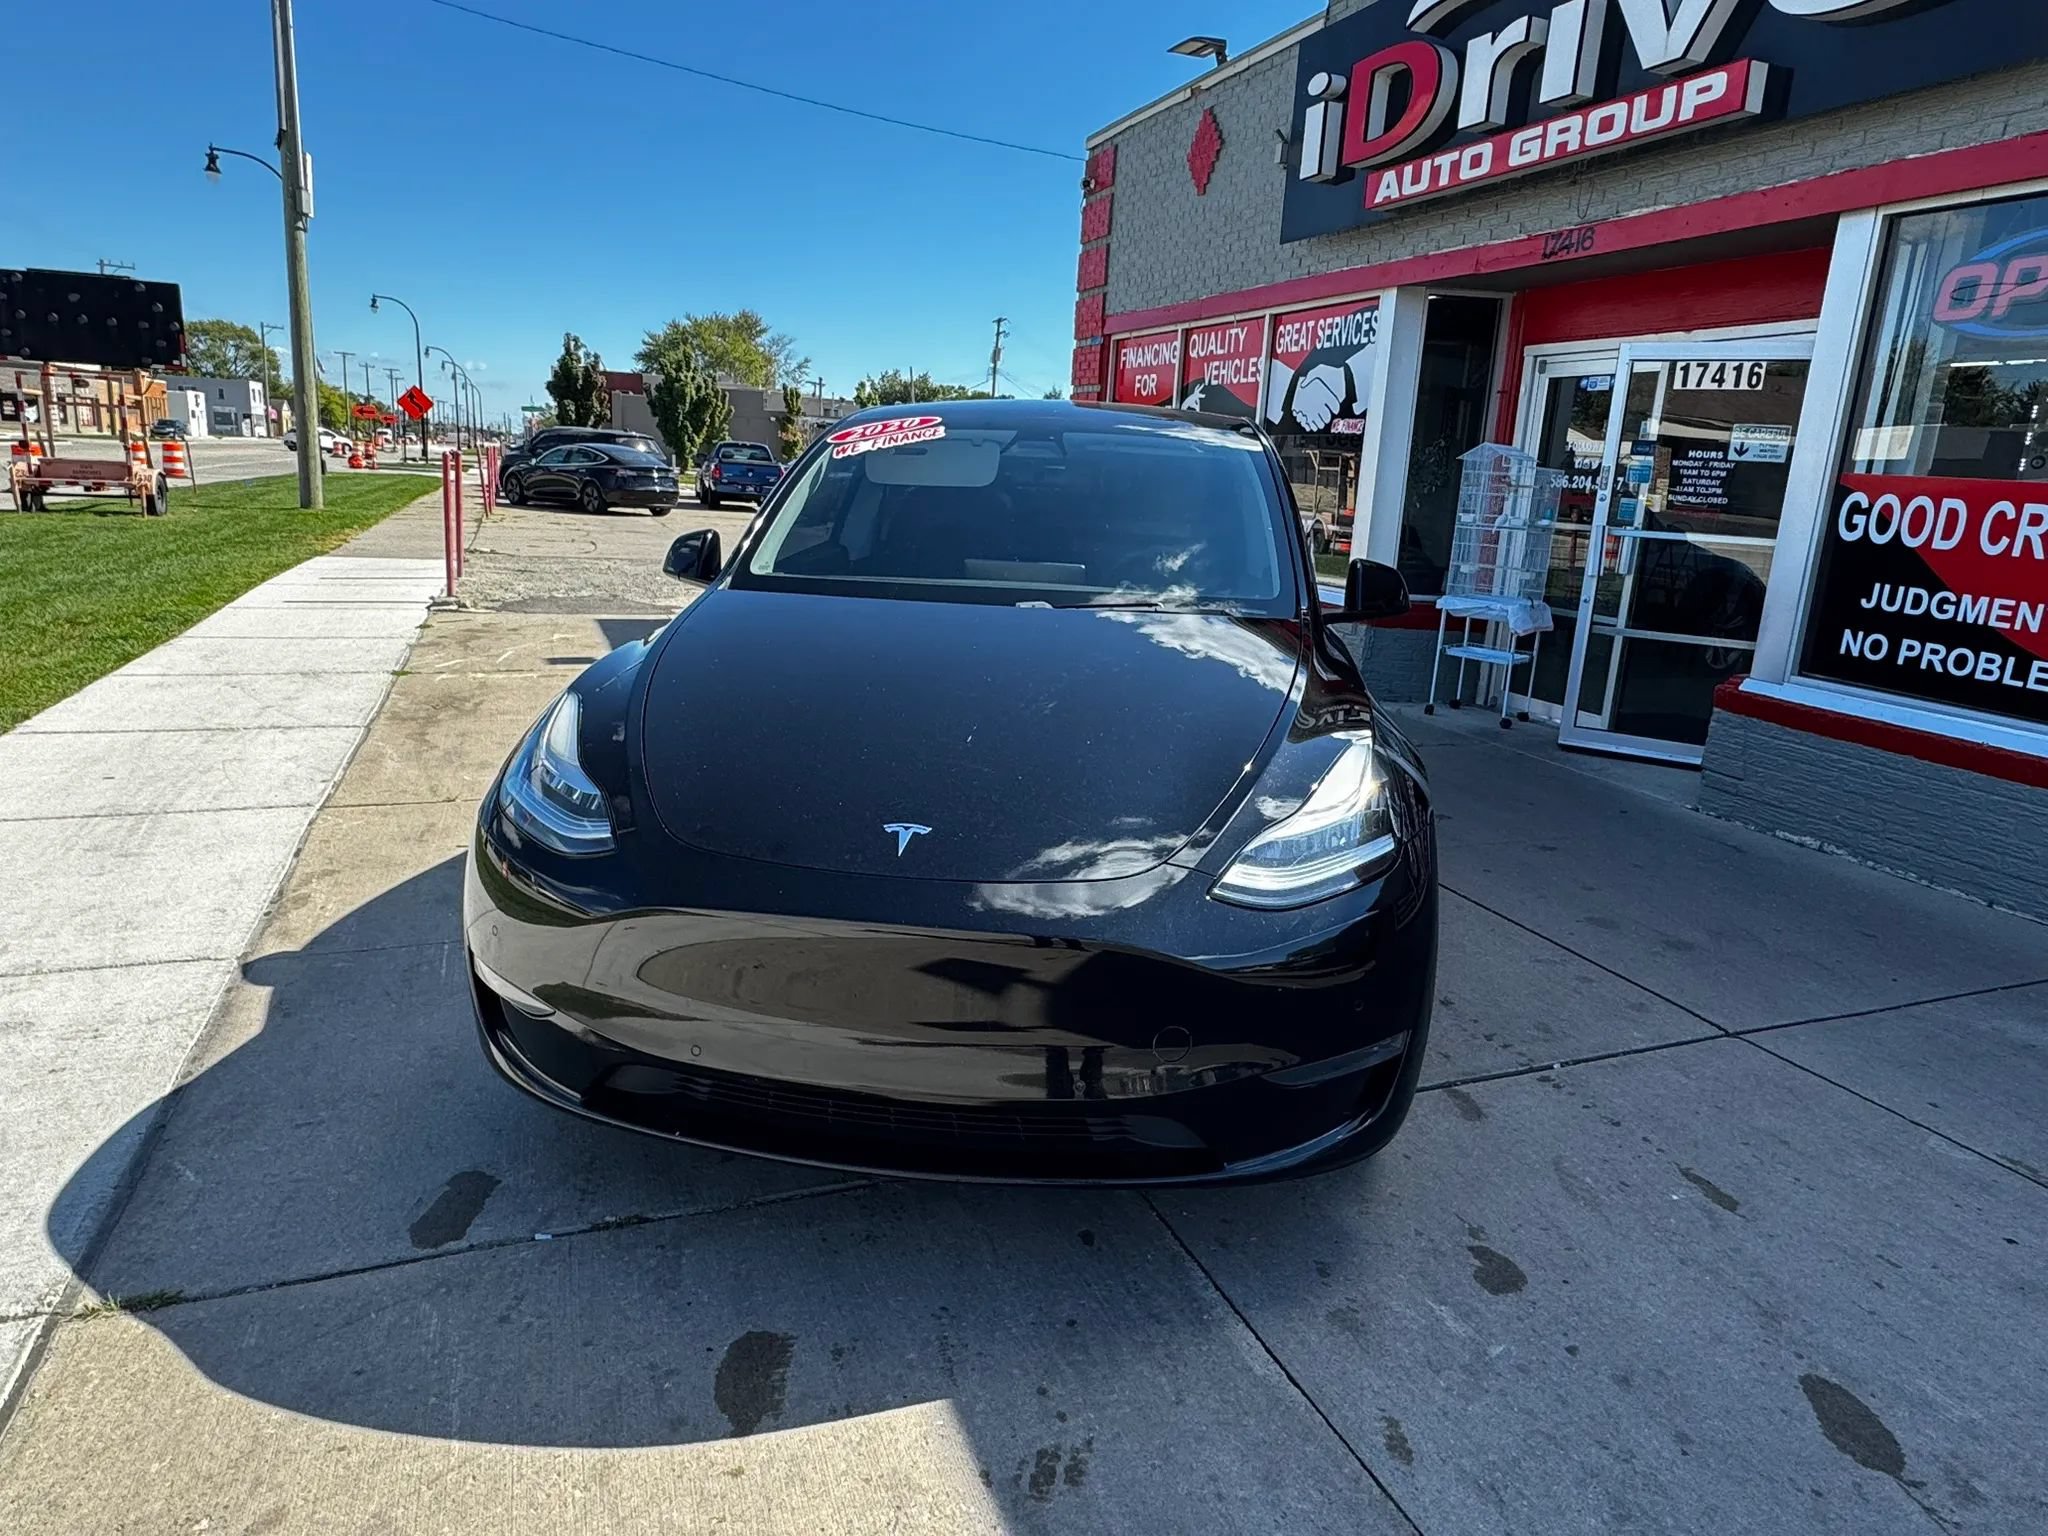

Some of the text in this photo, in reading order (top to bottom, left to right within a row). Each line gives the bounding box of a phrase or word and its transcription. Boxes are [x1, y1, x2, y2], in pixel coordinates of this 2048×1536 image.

[1373, 70, 1728, 204] AUTO GROUP
[1542, 226, 1596, 259] 17416
[1189, 327, 1248, 358] QUALITY
[1275, 310, 1380, 354] GREAT SERVICES
[1120, 340, 1180, 369] FINANCING
[1134, 373, 1158, 397] FOR
[1204, 356, 1263, 386] VEHICLES
[1680, 362, 1763, 389] 17416
[835, 428, 942, 457] WE FINANCE
[846, 417, 920, 440] 2020
[1672, 459, 1704, 468] MONDAY
[1709, 461, 1736, 469] FRIDAY
[1688, 450, 1724, 459] HOURS
[1682, 478, 1721, 487] SATURDAY
[1668, 493, 1728, 505] SUNDAY CLOSED
[1838, 491, 1967, 551] GOOD
[1860, 582, 2048, 633] JUDGMEN
[1840, 628, 1888, 661] NO
